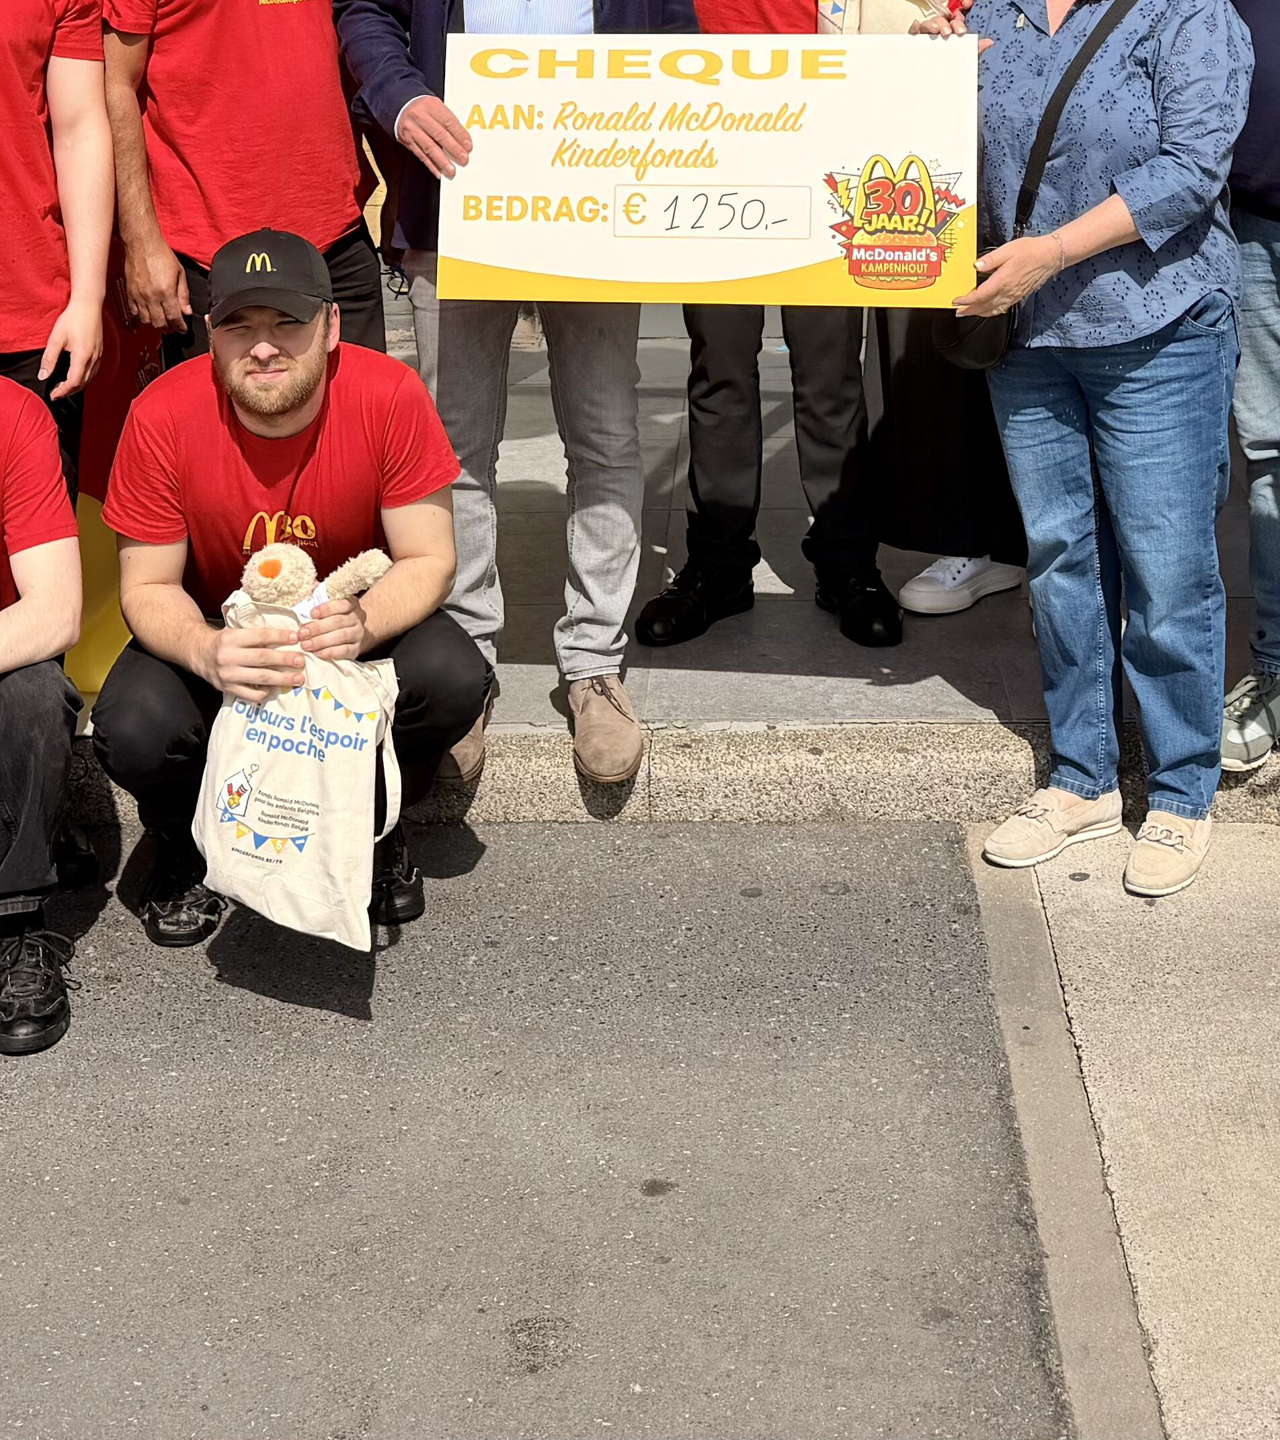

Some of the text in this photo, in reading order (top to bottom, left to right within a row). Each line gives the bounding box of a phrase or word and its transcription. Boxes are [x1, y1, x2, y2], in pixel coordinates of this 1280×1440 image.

[470, 48, 847, 86] CHEQUE
[465, 101, 807, 133] AAN: Ronald McDonald
[551, 137, 719, 181] Kinderfonds
[462, 195, 609, 223] BEDRAG:
[622, 192, 647, 225] €
[862, 176, 926, 221] 30
[863, 208, 933, 235] JAAR!
[852, 248, 938, 262] McDonald's
[861, 263, 928, 274] KAMPENHOUT
[233, 699, 368, 752] oujours l'espoir
[246, 726, 326, 763] en poche
